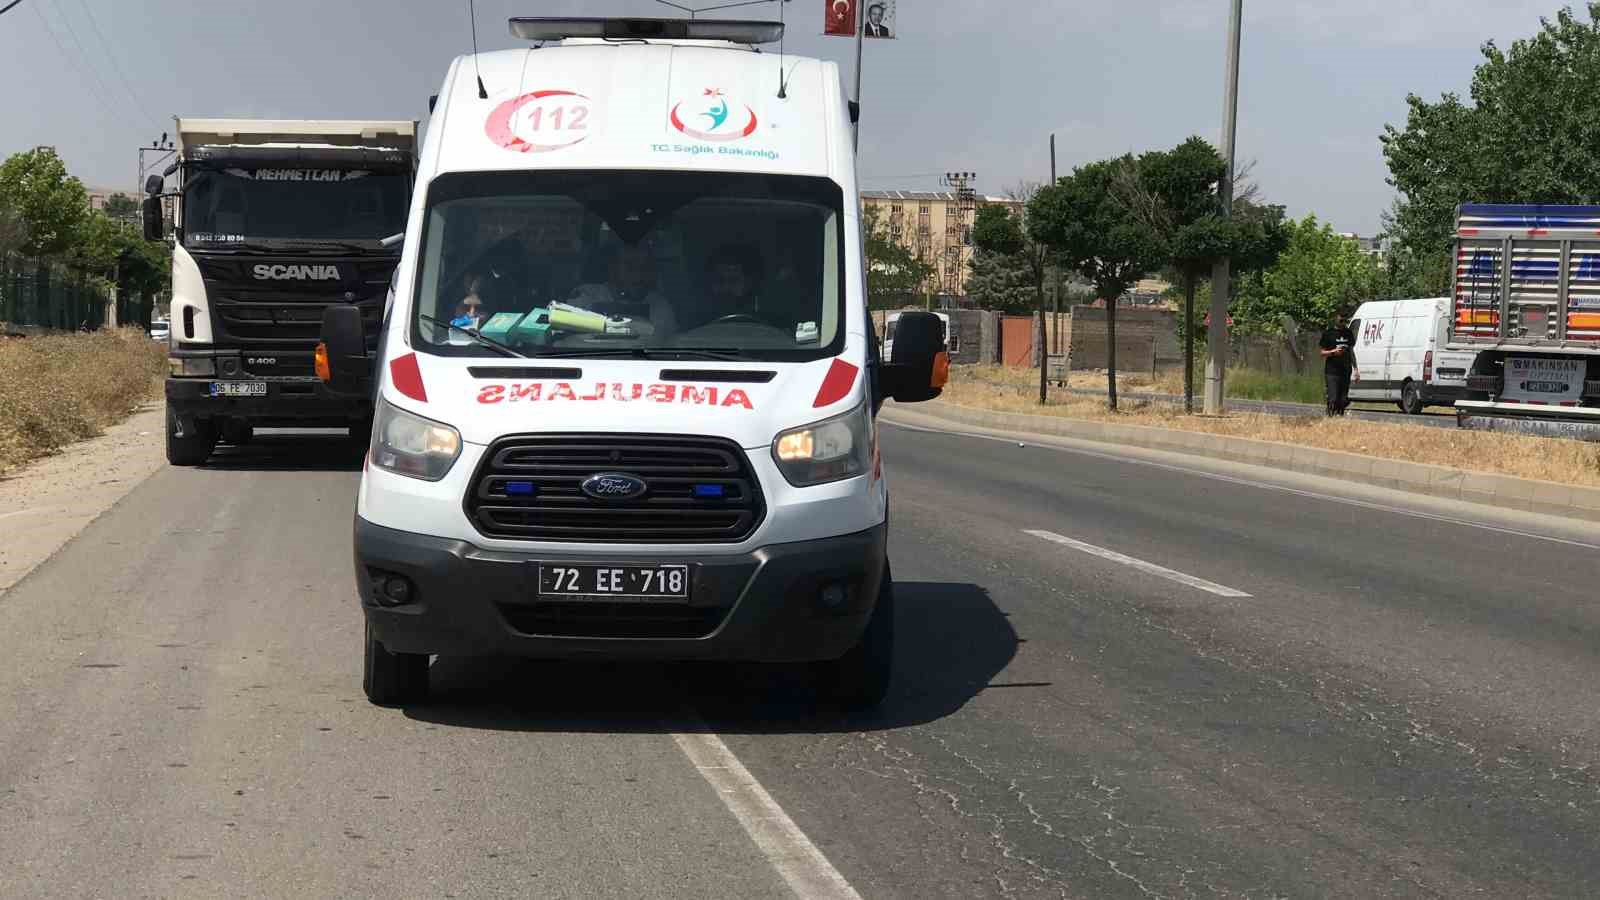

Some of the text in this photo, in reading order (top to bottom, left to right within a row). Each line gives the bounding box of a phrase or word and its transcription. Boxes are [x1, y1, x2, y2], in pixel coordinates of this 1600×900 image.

[527, 105, 589, 132] 112
[673, 144, 714, 154] Sağlık
[718, 146, 780, 160] Bakanlığı
[253, 264, 341, 281] SCANIA
[256, 357, 276, 365] 400
[244, 383, 265, 393] 7030
[597, 479, 632, 493] Ford
[552, 567, 682, 592] 72 EE 718
